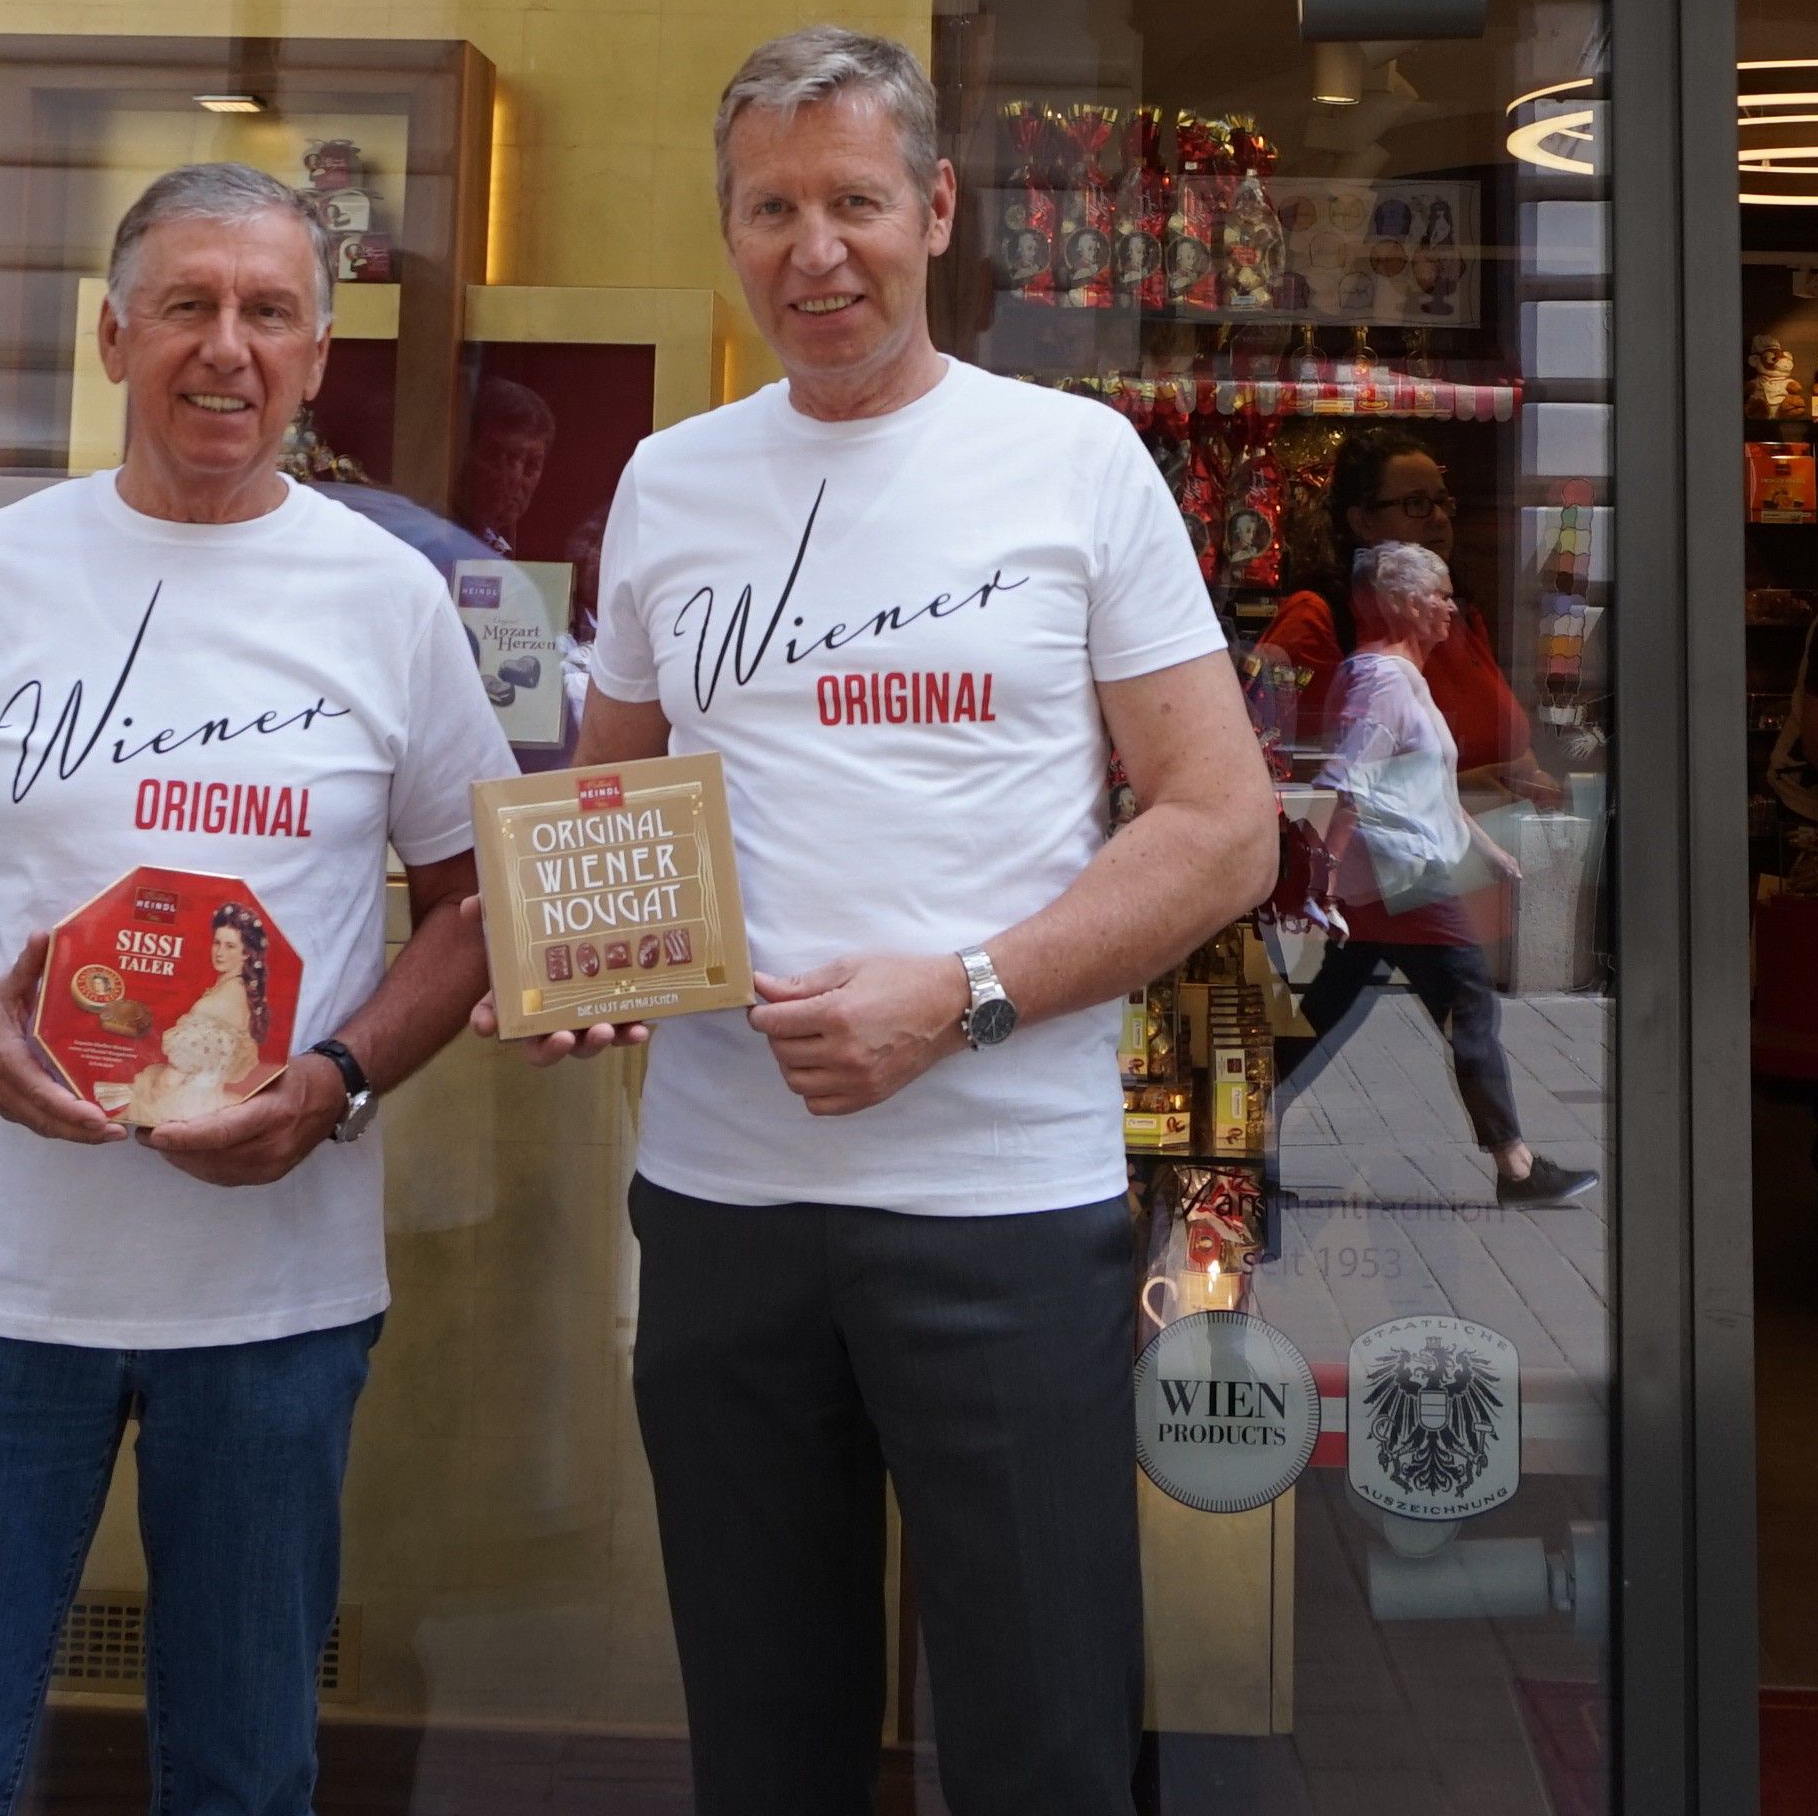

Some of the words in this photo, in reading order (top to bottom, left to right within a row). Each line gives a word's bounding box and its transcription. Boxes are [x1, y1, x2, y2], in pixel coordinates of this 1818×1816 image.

[675, 480, 1029, 714] Wiener
[482, 625, 541, 640] Mozart
[498, 637, 556, 651] Herzen
[817, 672, 997, 726] ORIGINAL
[134, 778, 312, 838] ORIGINAL
[580, 786, 620, 799] HEINDL
[532, 809, 674, 852] ORIGINAL
[536, 844, 679, 894] WIENER
[135, 899, 177, 913] HEINDL
[542, 884, 681, 935] NOUGAT
[115, 929, 184, 958] SISSI
[118, 955, 175, 976] TALER
[1317, 1247, 1403, 1279] 1953
[1361, 1319, 1508, 1352] STAATLICHE
[1158, 1379, 1290, 1419] WIEN
[1158, 1423, 1287, 1447] PRODUCTS
[1357, 1484, 1510, 1515] AUSZEICHNUNG
